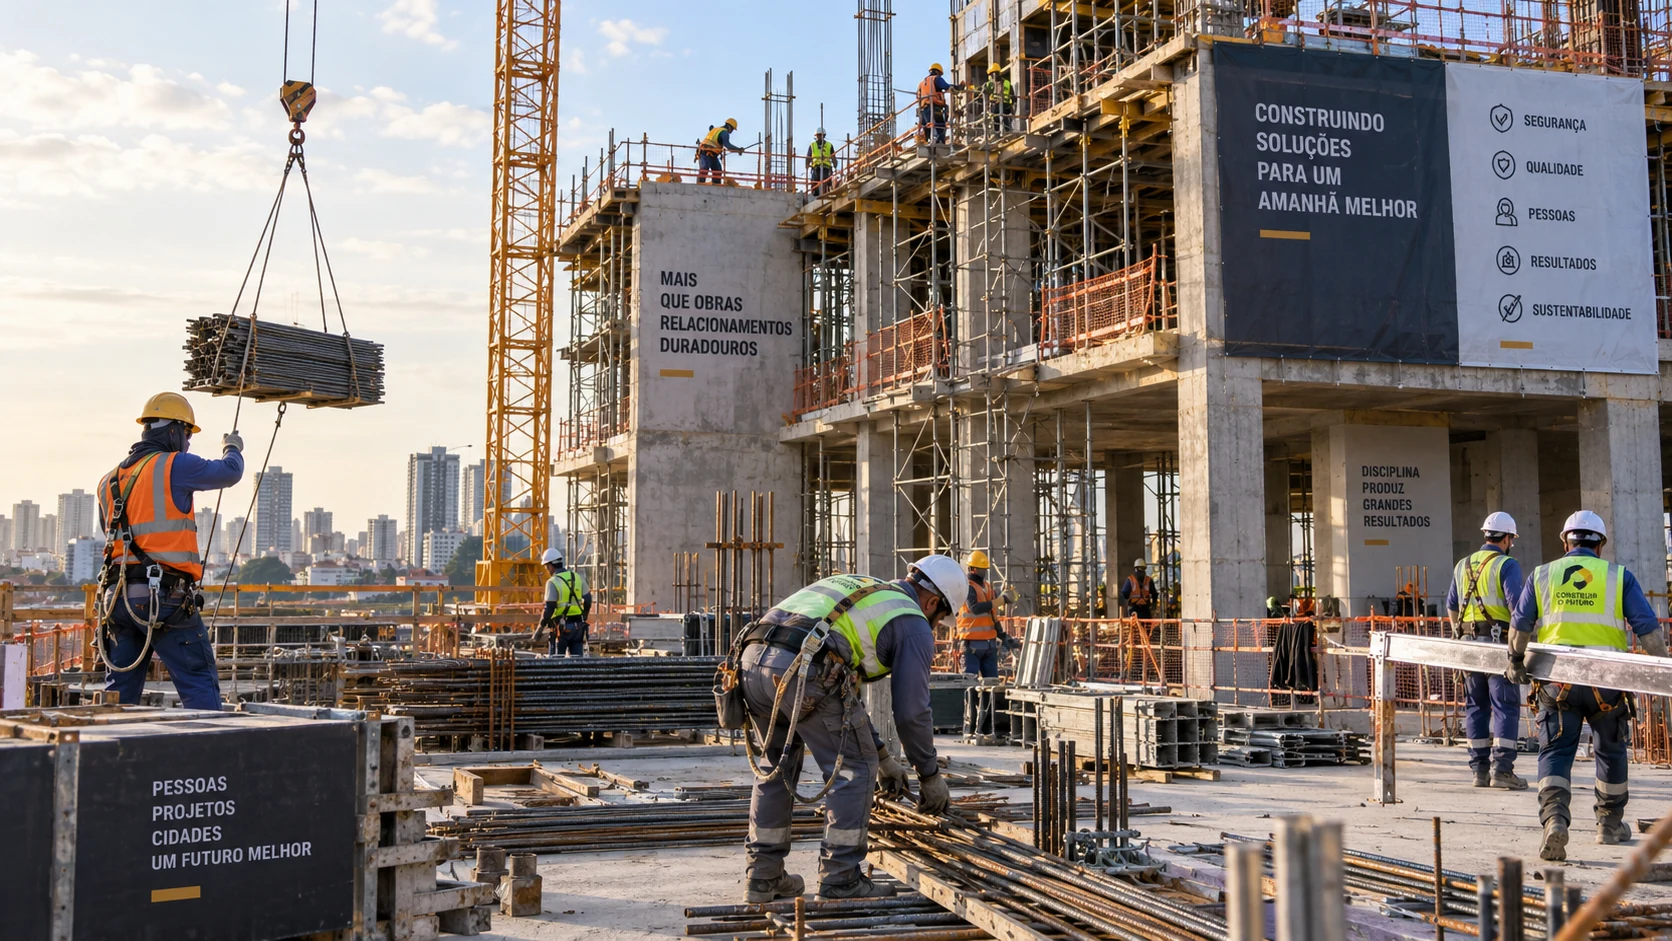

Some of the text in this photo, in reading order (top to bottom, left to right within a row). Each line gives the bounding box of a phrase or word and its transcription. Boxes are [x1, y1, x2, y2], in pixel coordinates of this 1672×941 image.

[1255, 102, 1385, 133] CONSTRUINDO
[1523, 114, 1587, 133] SEGURANÇA
[1256, 131, 1352, 160] SOLUÇÕES
[1257, 161, 1341, 186] PARA UM
[1526, 160, 1584, 177] QUALIDADE
[1258, 190, 1418, 219] AMANHÃ MELHOR
[1528, 207, 1576, 223] PESSOAS
[1530, 255, 1597, 271] RESULTADOS
[660, 270, 698, 288] MAIS
[660, 292, 743, 312] QUE OBRAS
[1532, 303, 1632, 320] SUSTENTABILIDADE
[660, 314, 793, 336] RELACIONAMENTOS
[660, 337, 758, 357] DURADOUROS
[1361, 465, 1420, 479] DISCIPLINA
[1362, 481, 1405, 495] PRODUZ
[1362, 498, 1413, 511] GRANDES
[1363, 515, 1431, 528] RESULTADOS
[152, 775, 227, 797] PESSOAS
[152, 799, 236, 822] PROJETOS
[152, 825, 222, 846] CIDADES
[151, 841, 312, 870] UM FUTURO MELHOR
